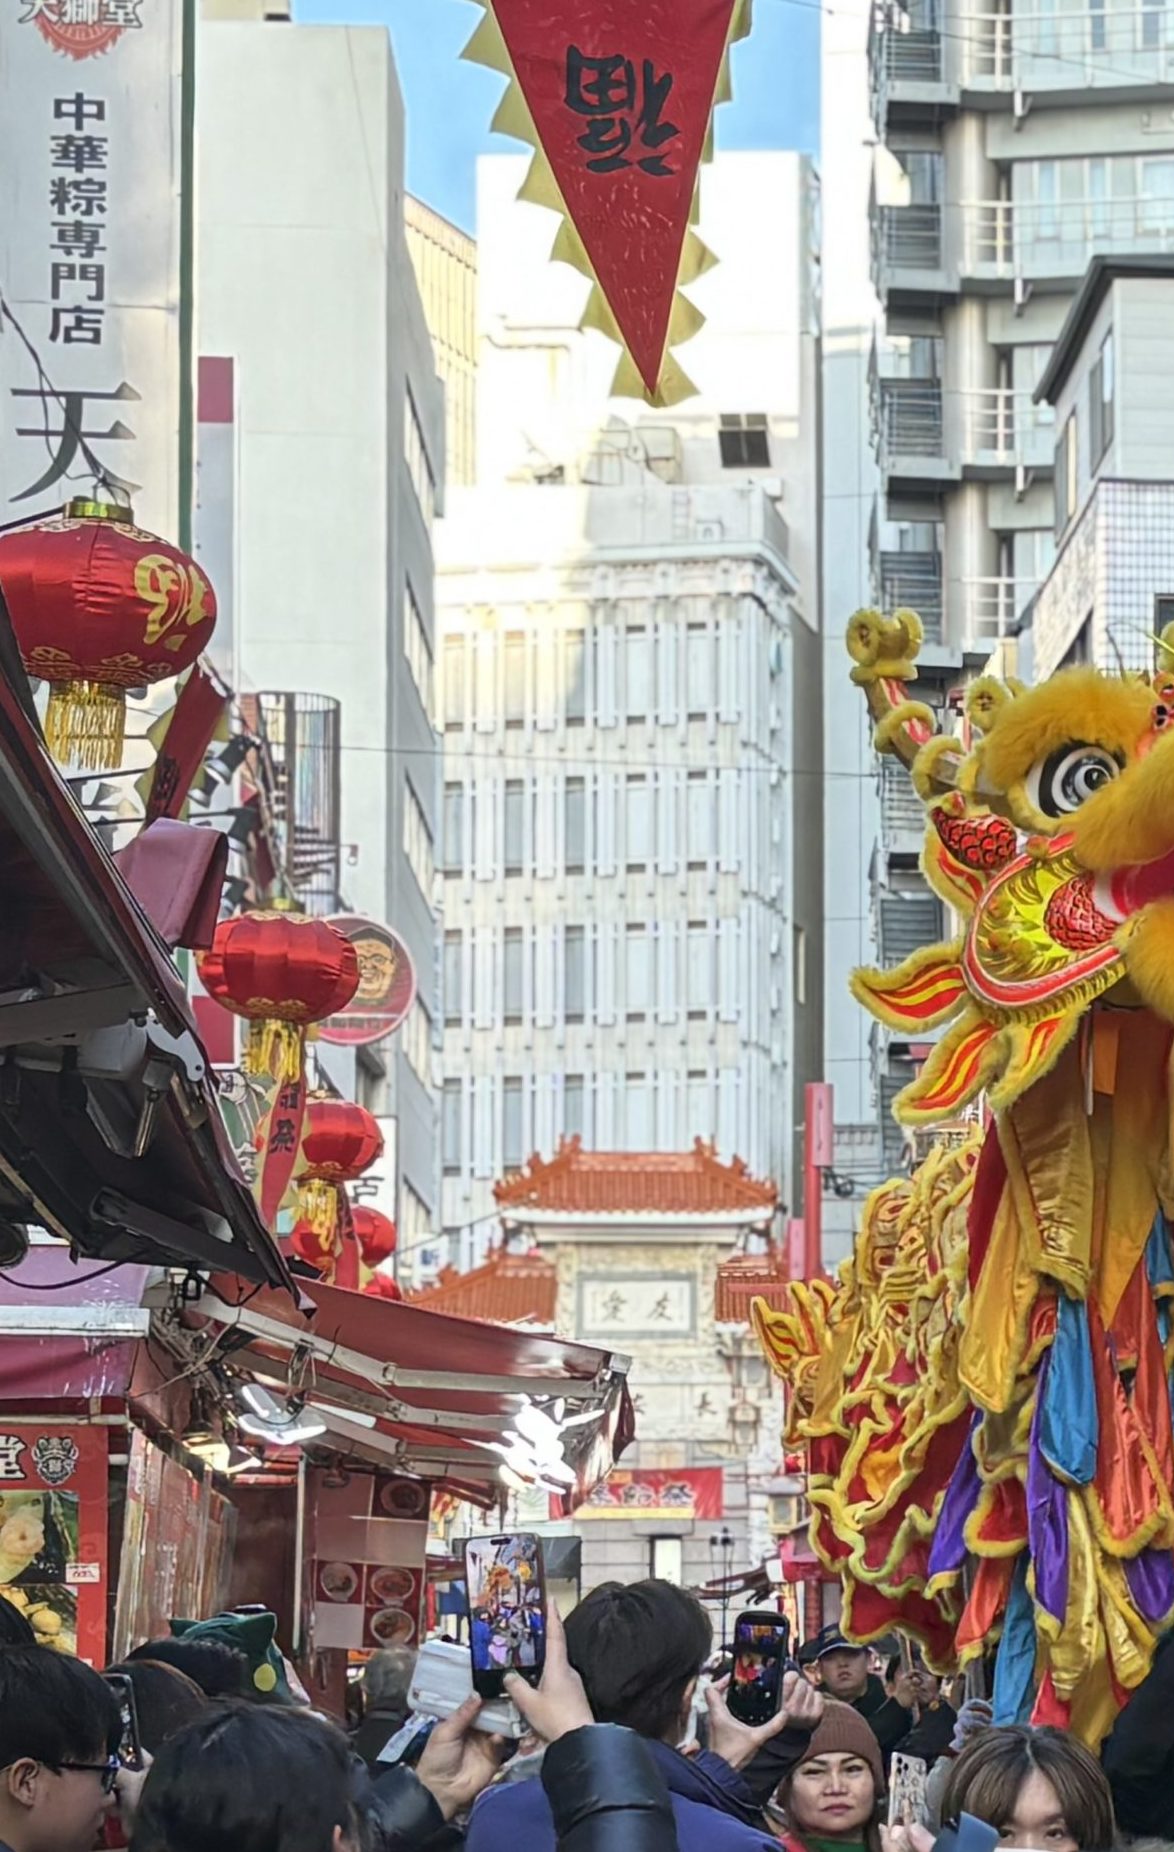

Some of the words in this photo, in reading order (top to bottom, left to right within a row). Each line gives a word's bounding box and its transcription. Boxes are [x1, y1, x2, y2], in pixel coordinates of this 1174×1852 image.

[50, 92, 108, 345] 中華粽専門店
